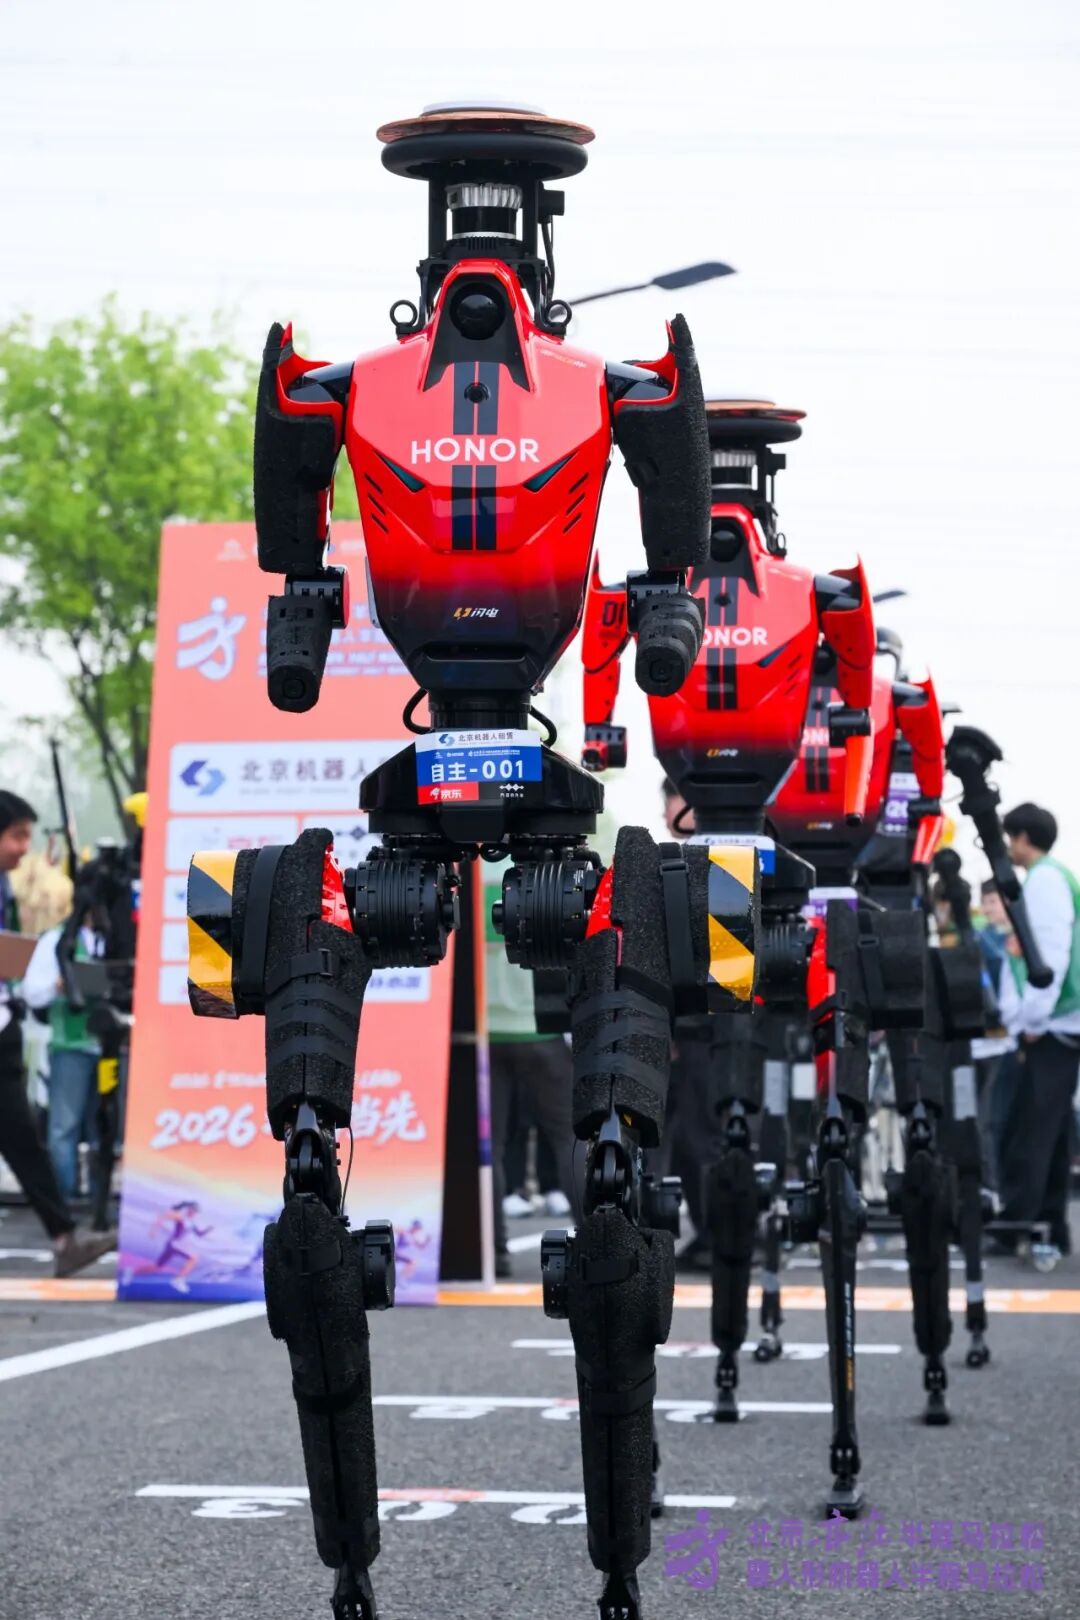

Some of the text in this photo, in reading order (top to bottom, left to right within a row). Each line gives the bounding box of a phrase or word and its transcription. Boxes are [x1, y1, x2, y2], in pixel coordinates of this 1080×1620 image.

[411, 437, 540, 464] HONOR
[470, 607, 499, 618] 闪电
[702, 627, 768, 646] ONOR
[240, 757, 388, 782] 北京机器人
[431, 759, 524, 783] 自主-001
[441, 788, 462, 800] 京东
[148, 1102, 256, 1150] 2026
